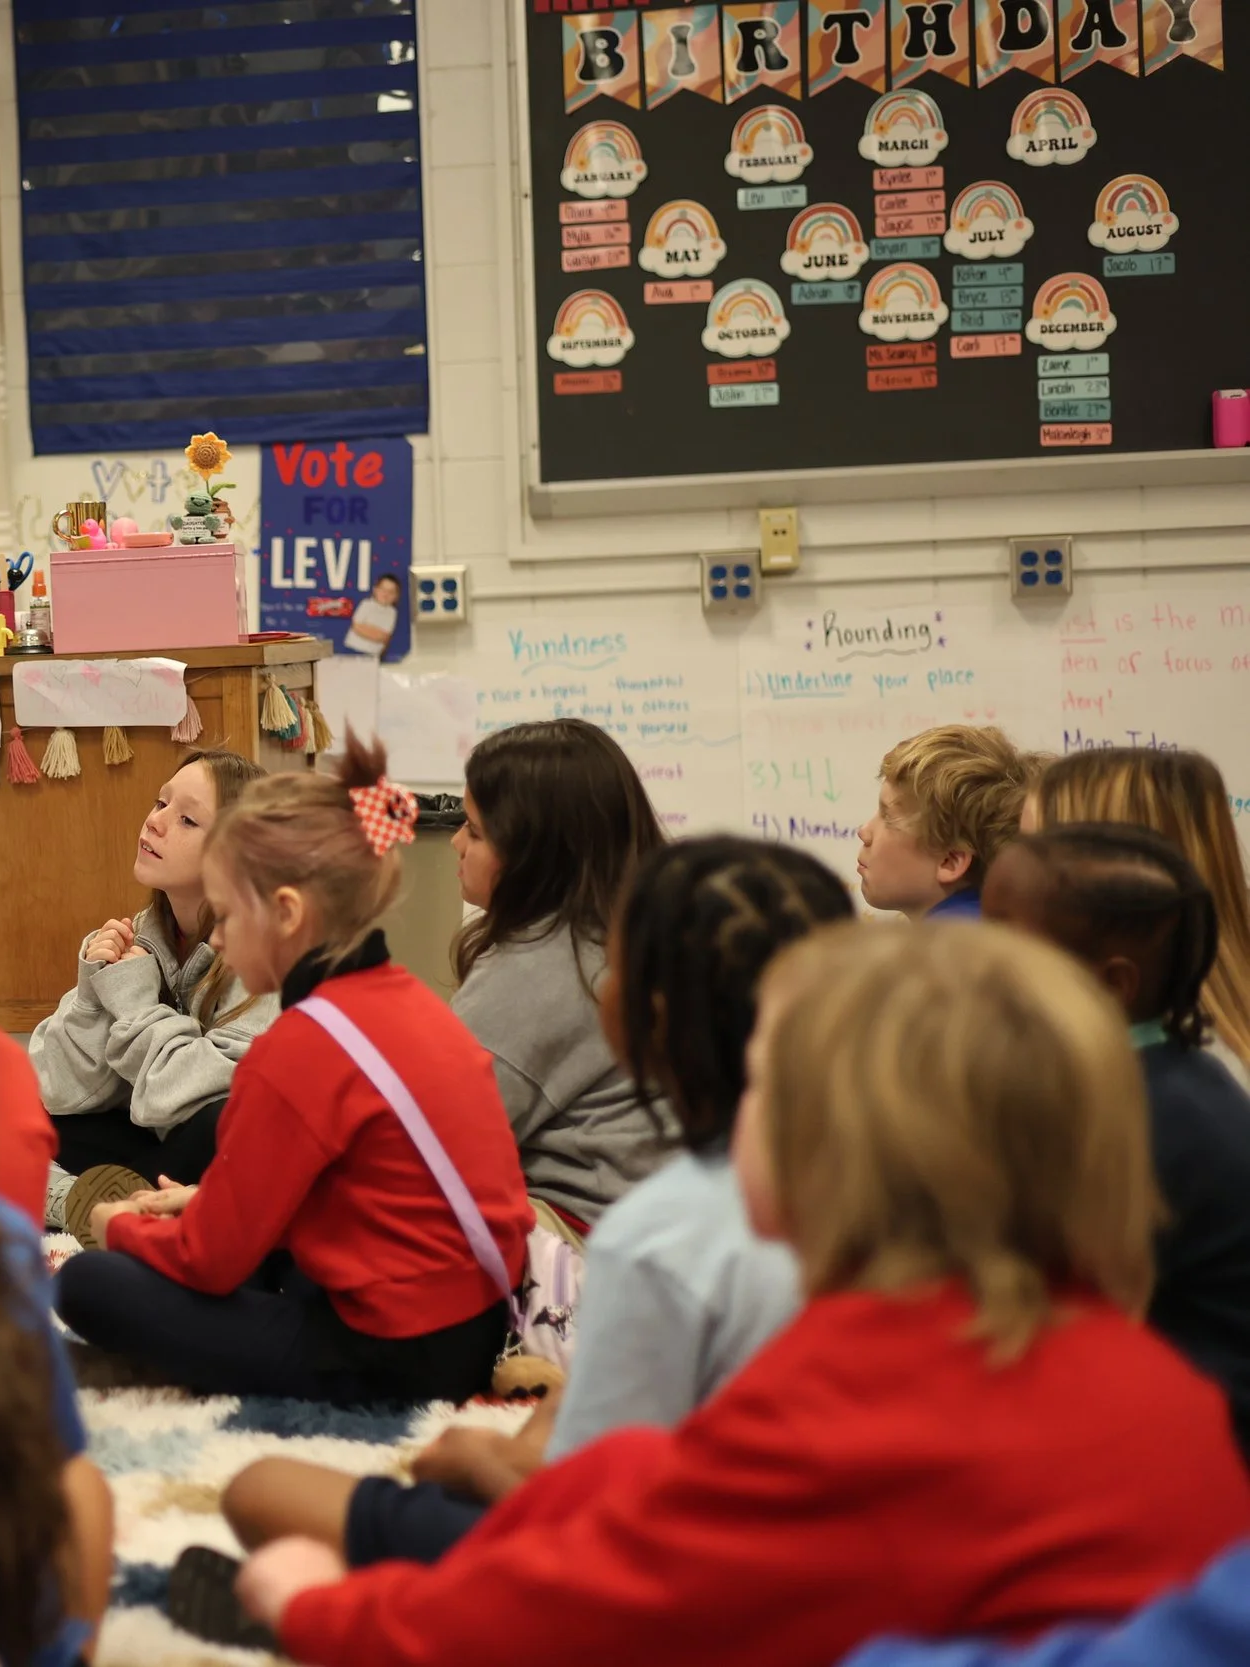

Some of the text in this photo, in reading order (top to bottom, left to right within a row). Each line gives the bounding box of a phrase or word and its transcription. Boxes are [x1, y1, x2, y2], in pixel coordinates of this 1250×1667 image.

[578, 0, 1197, 84] BIRTHDAY
[878, 139, 929, 152] MARCH
[1025, 136, 1078, 154] APRIL
[738, 154, 799, 169] FEBRUARY
[574, 171, 633, 183] JANUARY
[969, 229, 1006, 244] JULY
[1106, 224, 1163, 239] AUGUST
[665, 249, 702, 264] MAY
[803, 253, 849, 269] JUNE
[1106, 257, 1138, 273] Jacob
[871, 312, 936, 325] NOVEMBER
[717, 326, 778, 341] OCTOBER
[1040, 321, 1105, 335] DECEMBER
[561, 336, 623, 351] SEPTEMBER
[272, 440, 384, 488] Vote
[304, 495, 369, 526] FOR
[271, 537, 372, 592] LEVI
[1150, 602, 1198, 632] the
[823, 610, 933, 652] Rounding
[1164, 646, 1214, 675] focus
[767, 667, 976, 698] Underline your place
